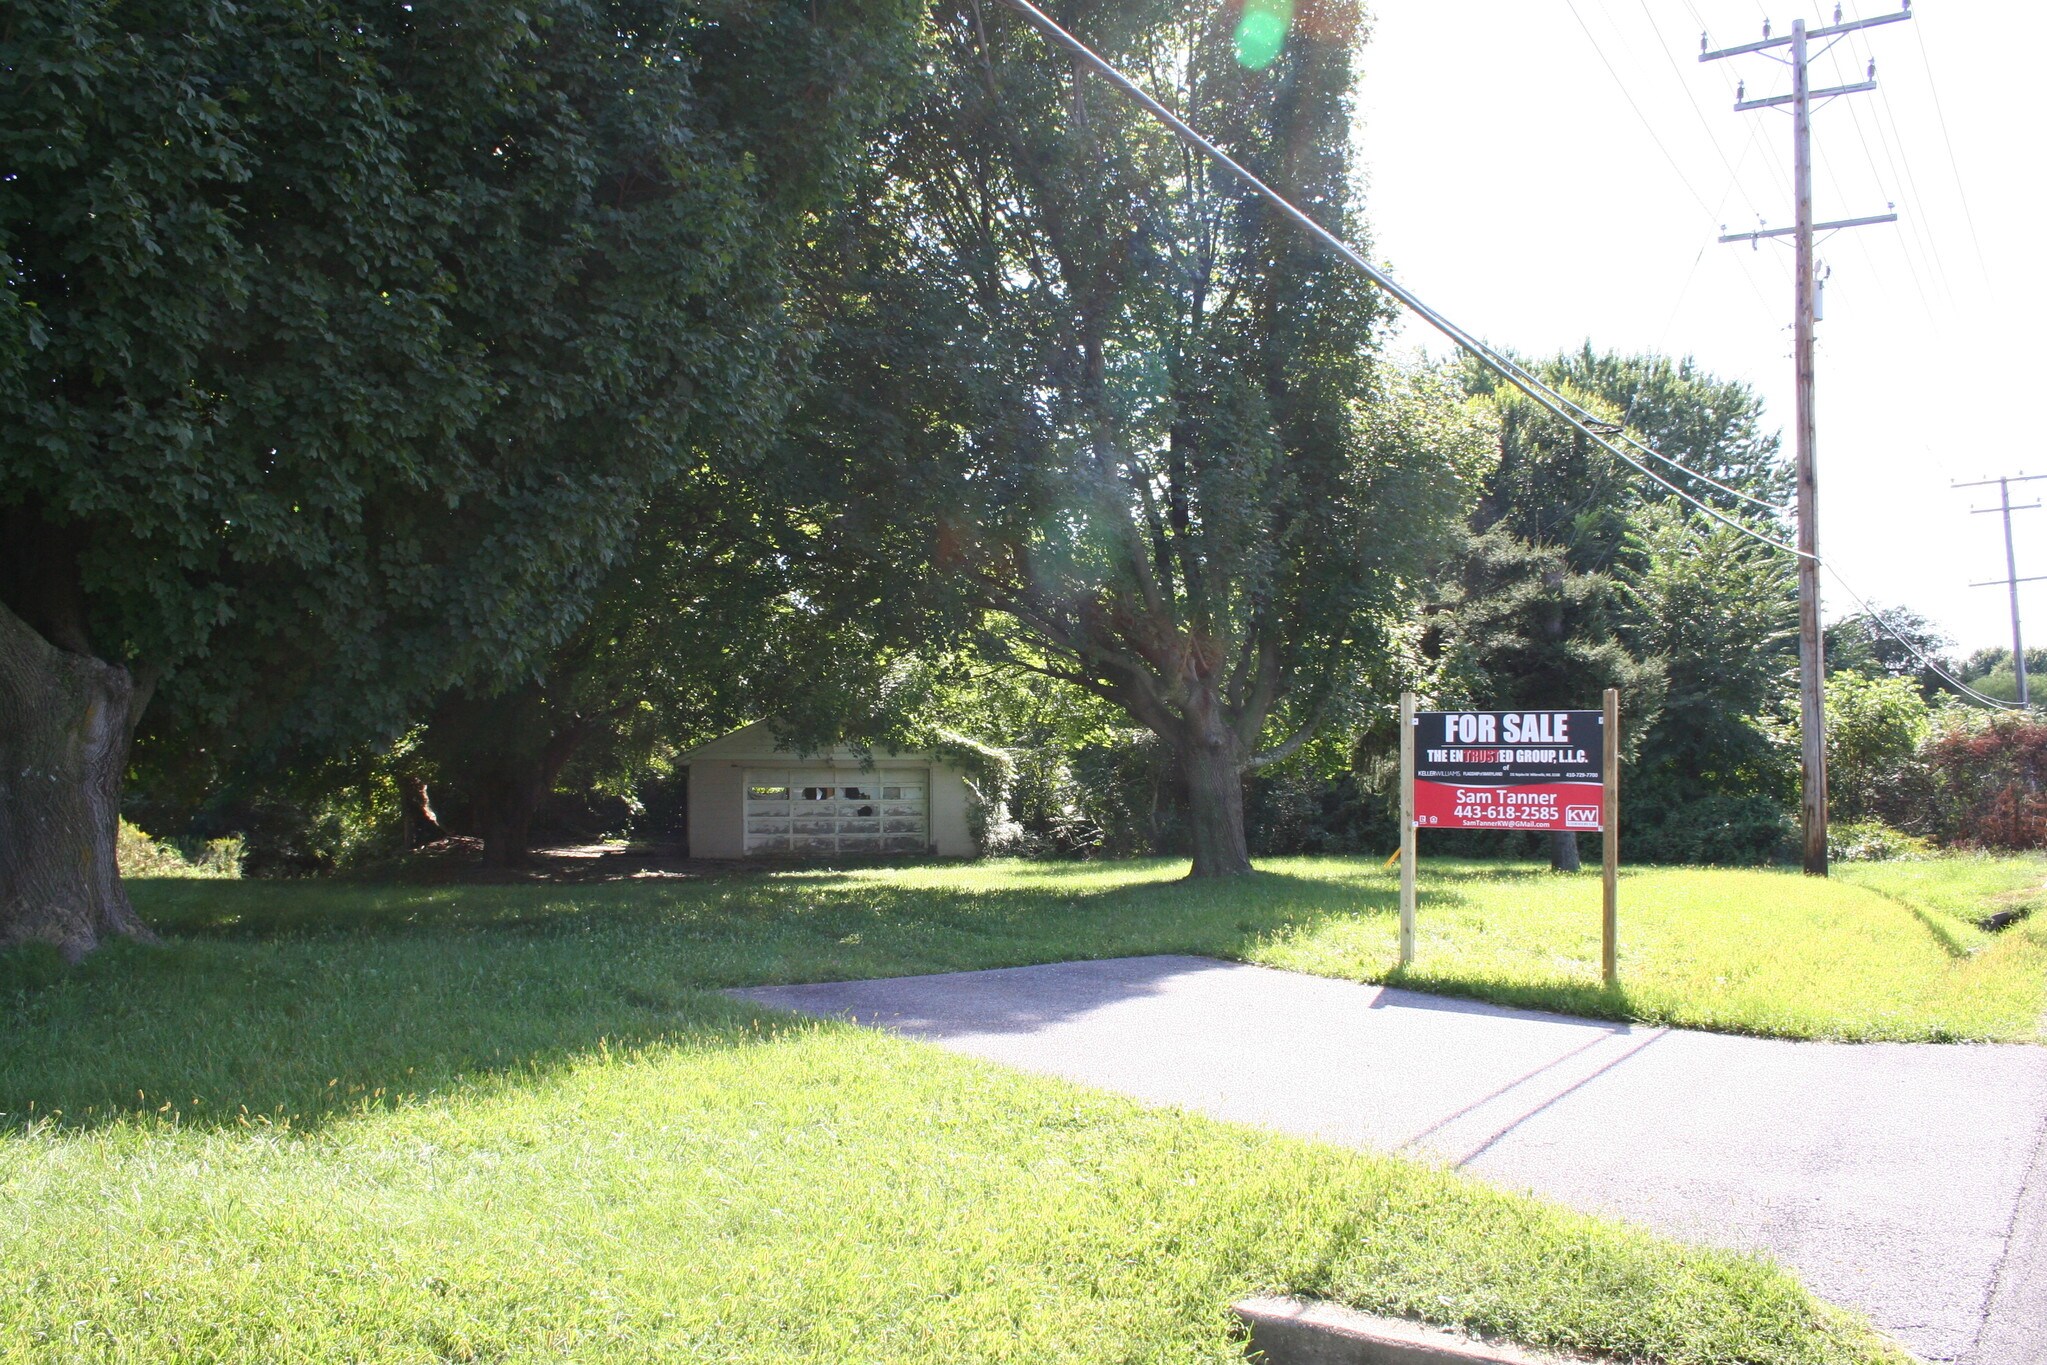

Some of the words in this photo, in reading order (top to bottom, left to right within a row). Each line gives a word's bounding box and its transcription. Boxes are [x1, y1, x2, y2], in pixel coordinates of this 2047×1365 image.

[1445, 714, 1496, 743] FOR
[1503, 714, 1568, 743] SALE
[1427, 749, 1447, 763] THE
[1449, 749, 1513, 763] ENTRUSTED
[1516, 749, 1557, 764] GROUP,
[1559, 749, 1588, 763] L.L.C.
[1456, 789, 1492, 804] Sam
[1496, 790, 1557, 805] Tanner
[1454, 805, 1559, 820] 443-618-2585
[1568, 809, 1596, 821] KW
[1462, 819, 1550, 828] SamTannerKW@GMail.com
